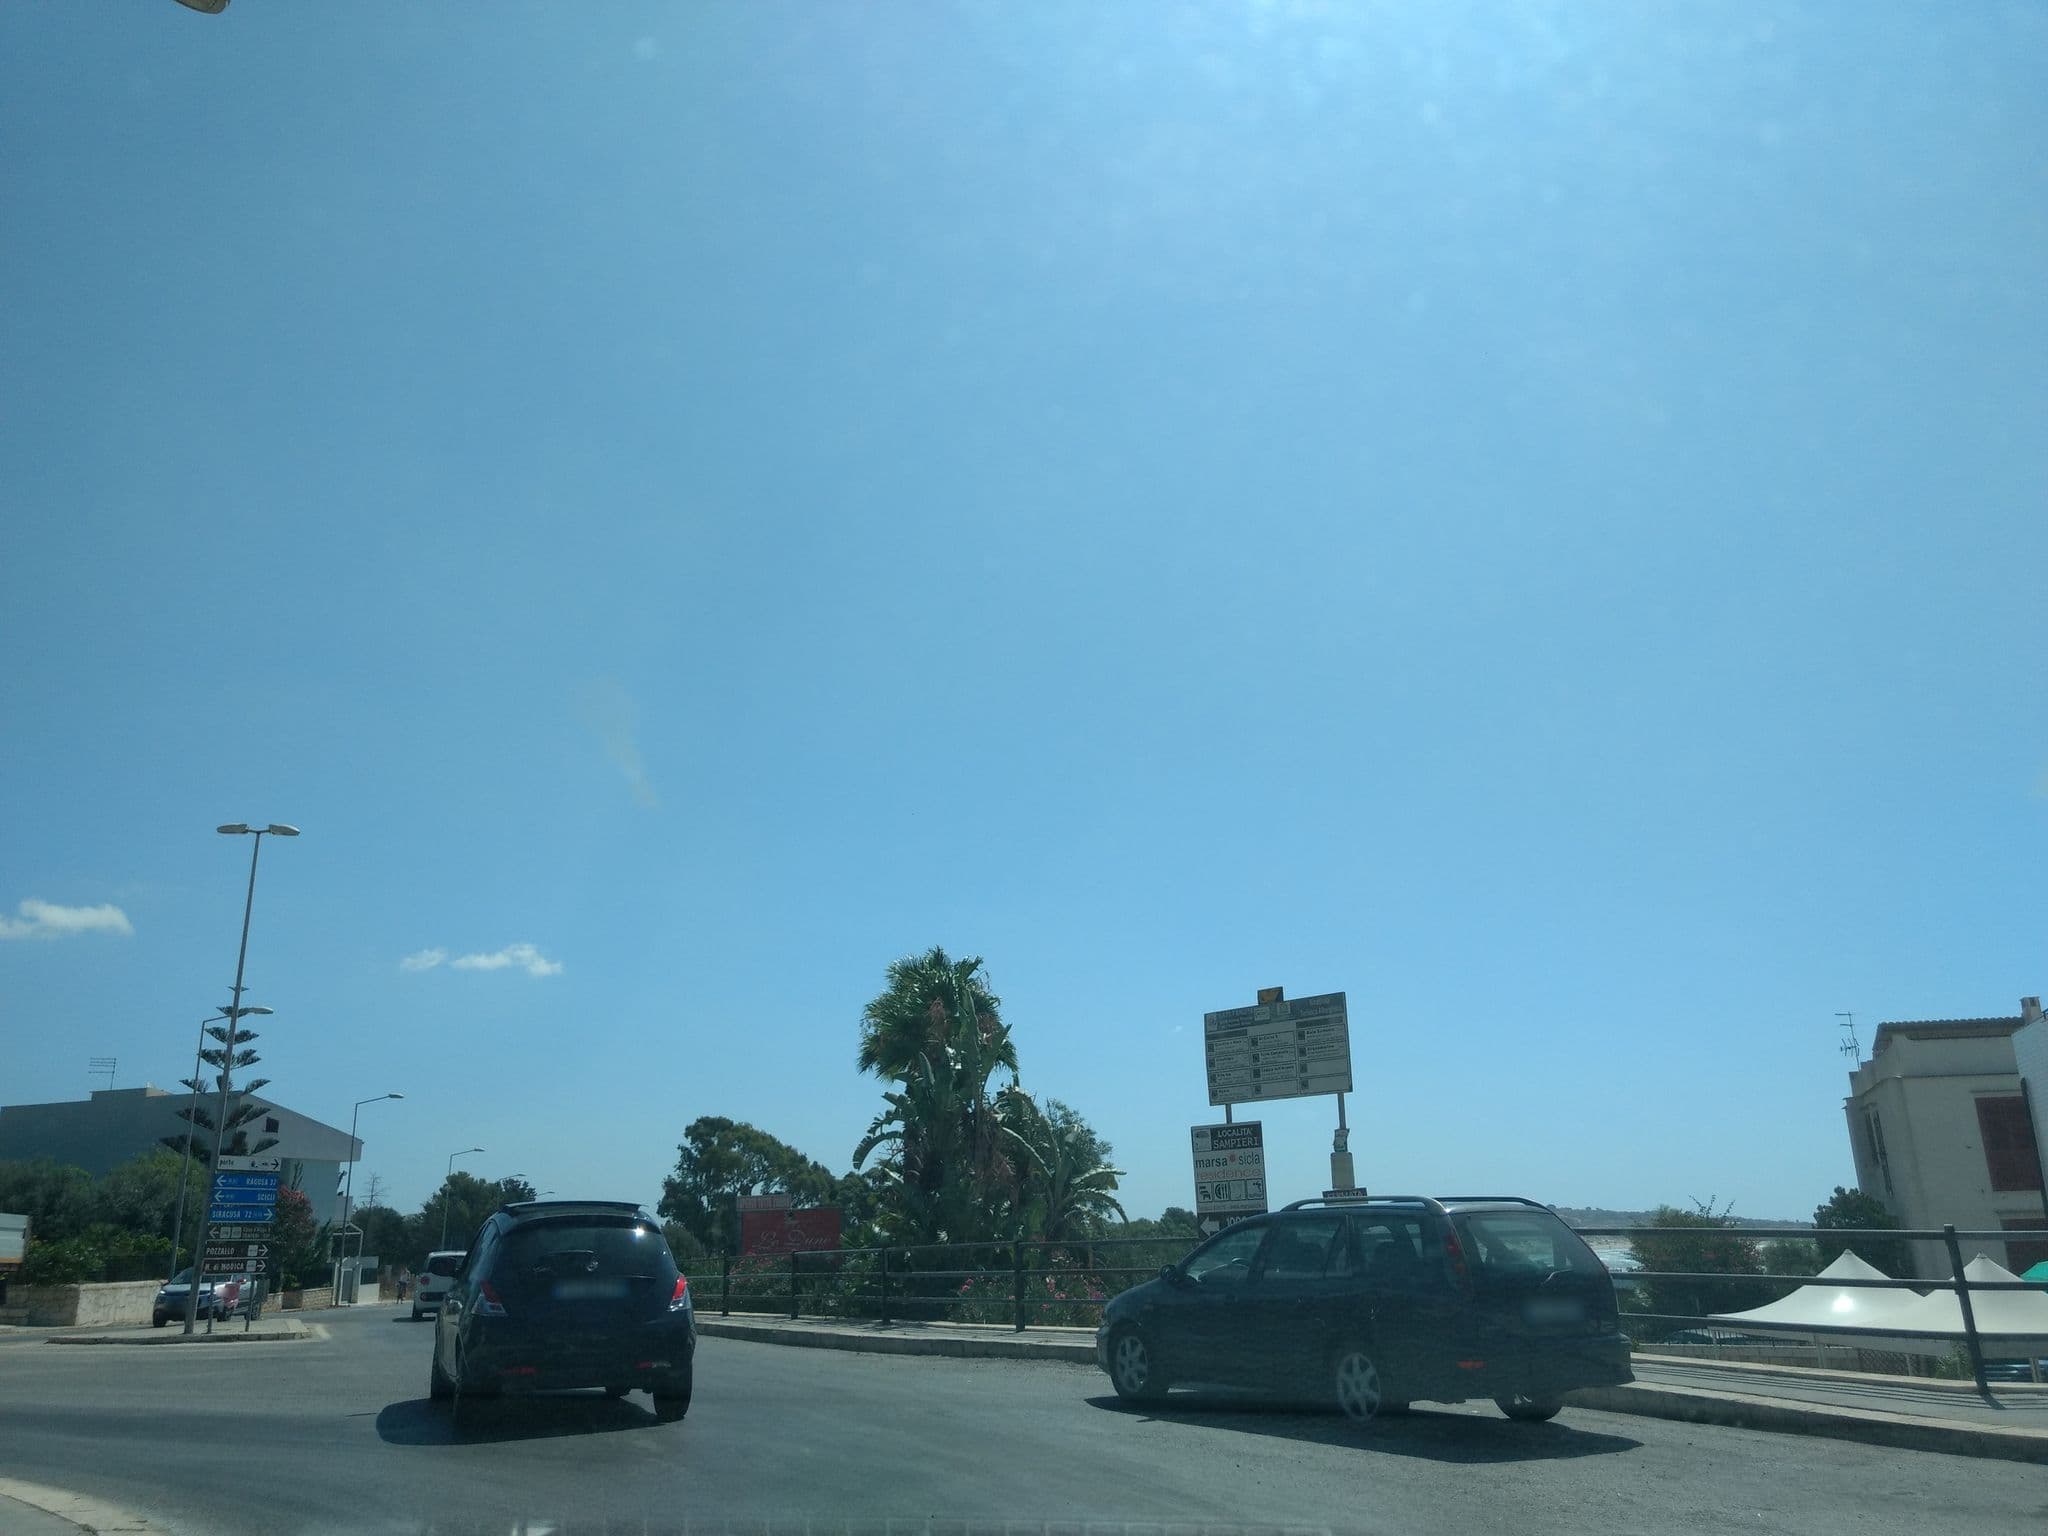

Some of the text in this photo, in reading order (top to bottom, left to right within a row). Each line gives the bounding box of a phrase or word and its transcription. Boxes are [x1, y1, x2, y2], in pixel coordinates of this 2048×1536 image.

[1213, 1136, 1259, 1150] SAMPIERI
[1195, 1151, 1260, 1168] marsa sicla
[246, 1177, 268, 1185] RAGUSA
[257, 1192, 275, 1201] SCICLI
[212, 1210, 241, 1218] SIRACUSA
[206, 1247, 235, 1255] POZZALLO
[221, 1262, 245, 1271] MODICA
